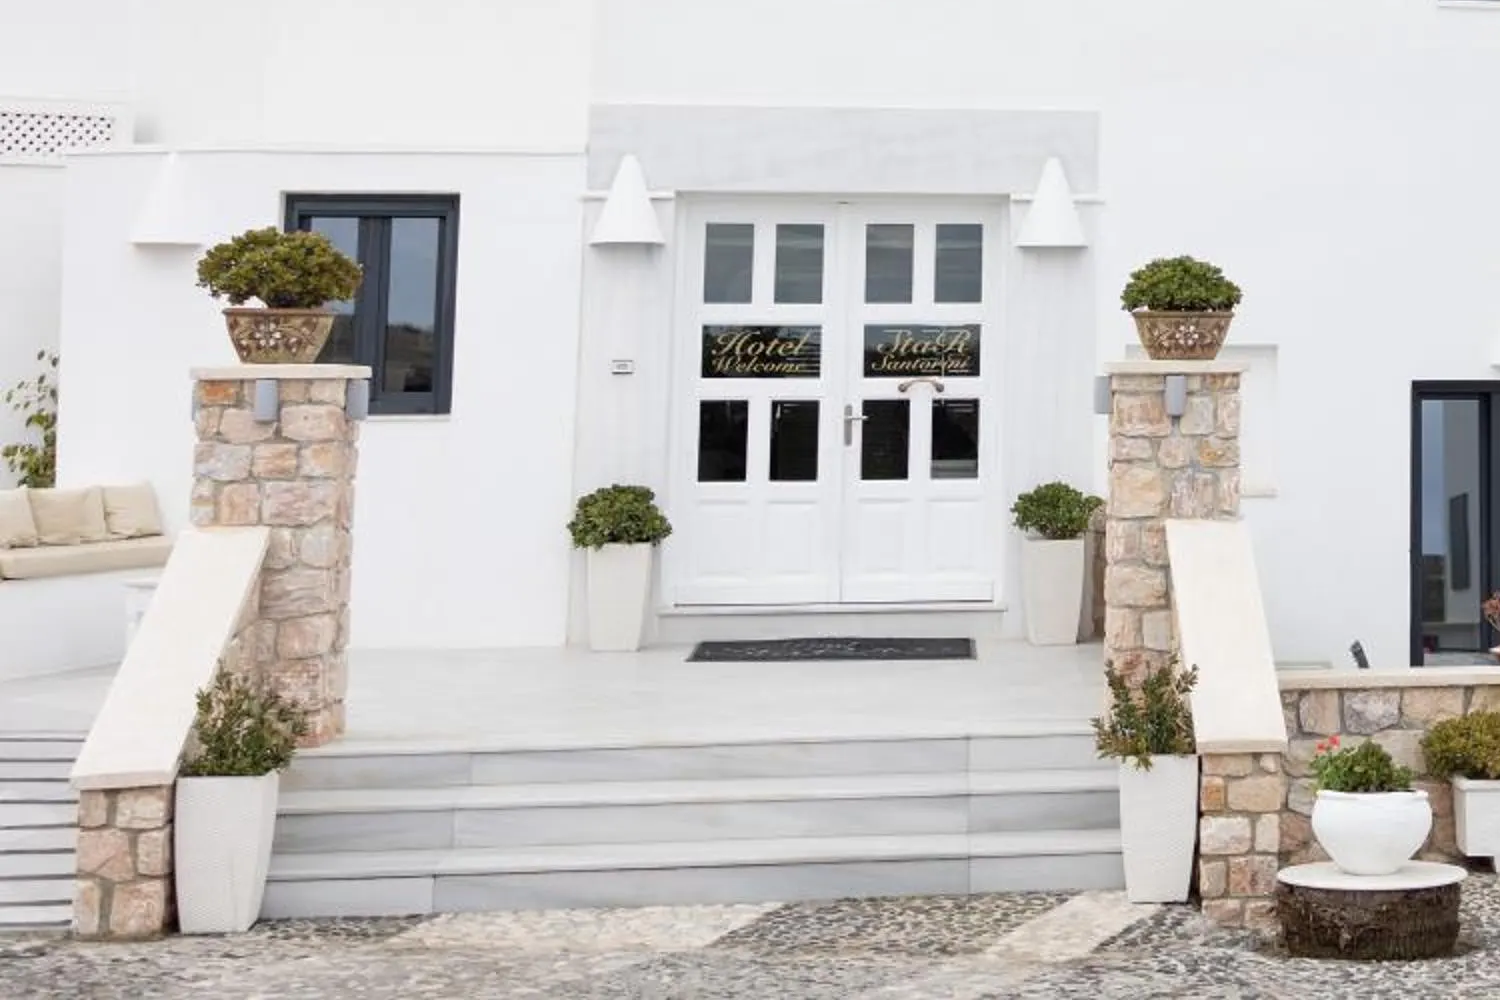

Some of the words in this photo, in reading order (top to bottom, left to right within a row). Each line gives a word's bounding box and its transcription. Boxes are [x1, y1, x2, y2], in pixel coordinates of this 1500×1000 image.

[711, 330, 810, 356] Hotel
[711, 355, 803, 373] Welcome
[871, 353, 970, 372] Santorini
